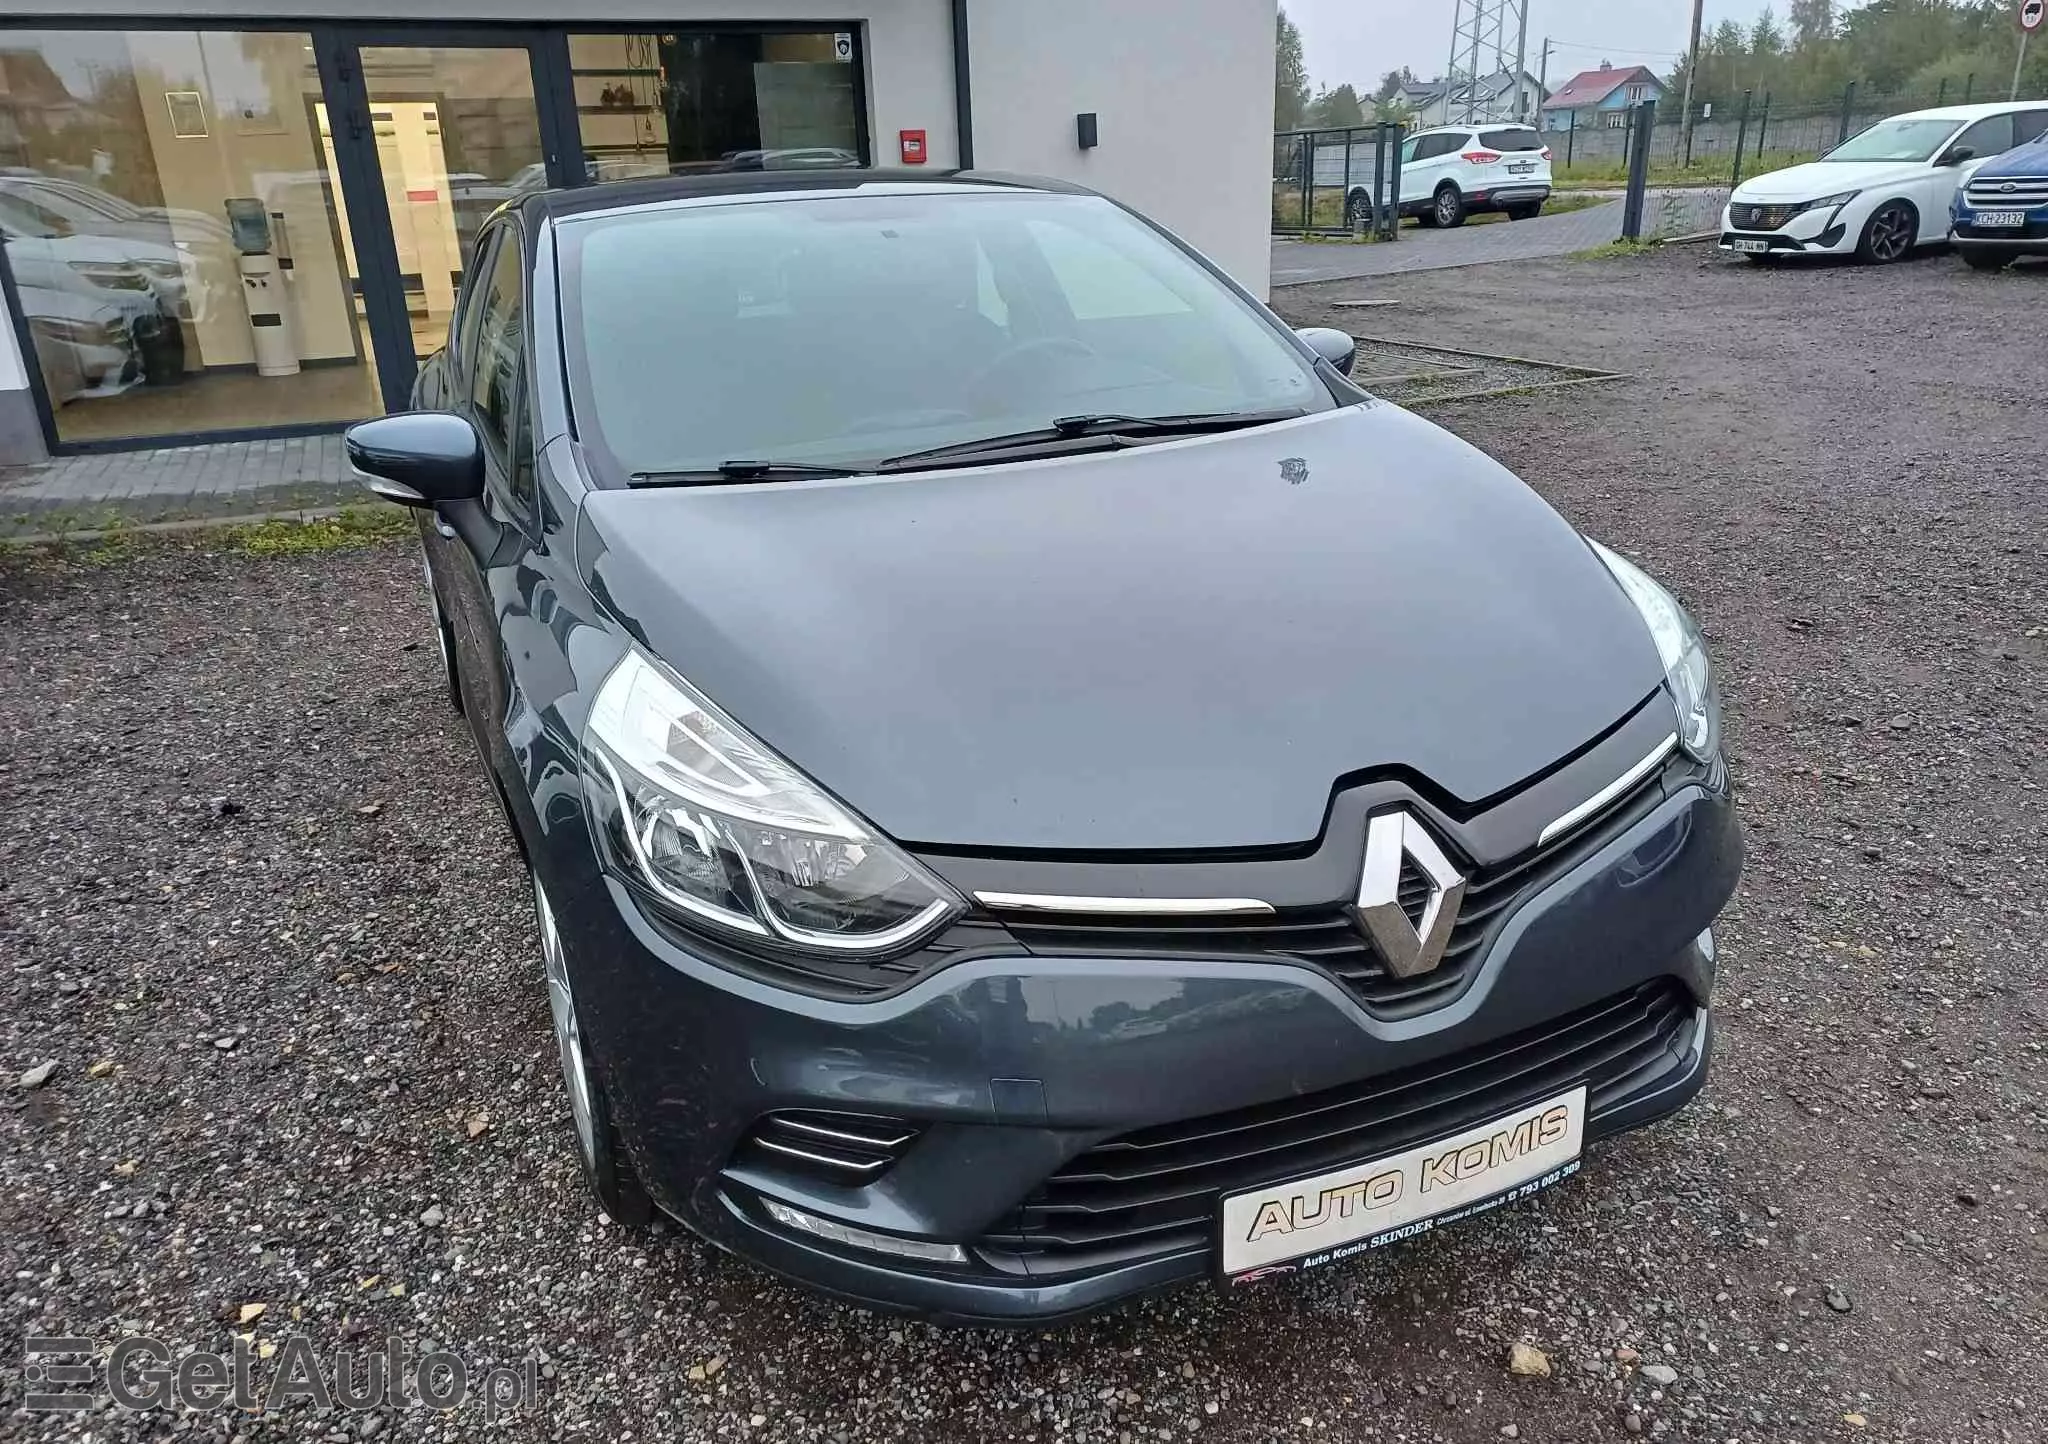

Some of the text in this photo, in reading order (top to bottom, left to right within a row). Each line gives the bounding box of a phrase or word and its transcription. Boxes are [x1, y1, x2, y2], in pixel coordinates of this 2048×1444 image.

[1247, 1104, 1568, 1242] AUTO KOMIS
[1303, 1254, 1330, 1269] Auto
[1333, 1241, 1367, 1260] Komis
[1370, 1219, 1433, 1249] SKINDER
[1519, 1181, 1539, 1197] 793
[1541, 1170, 1561, 1188] 002
